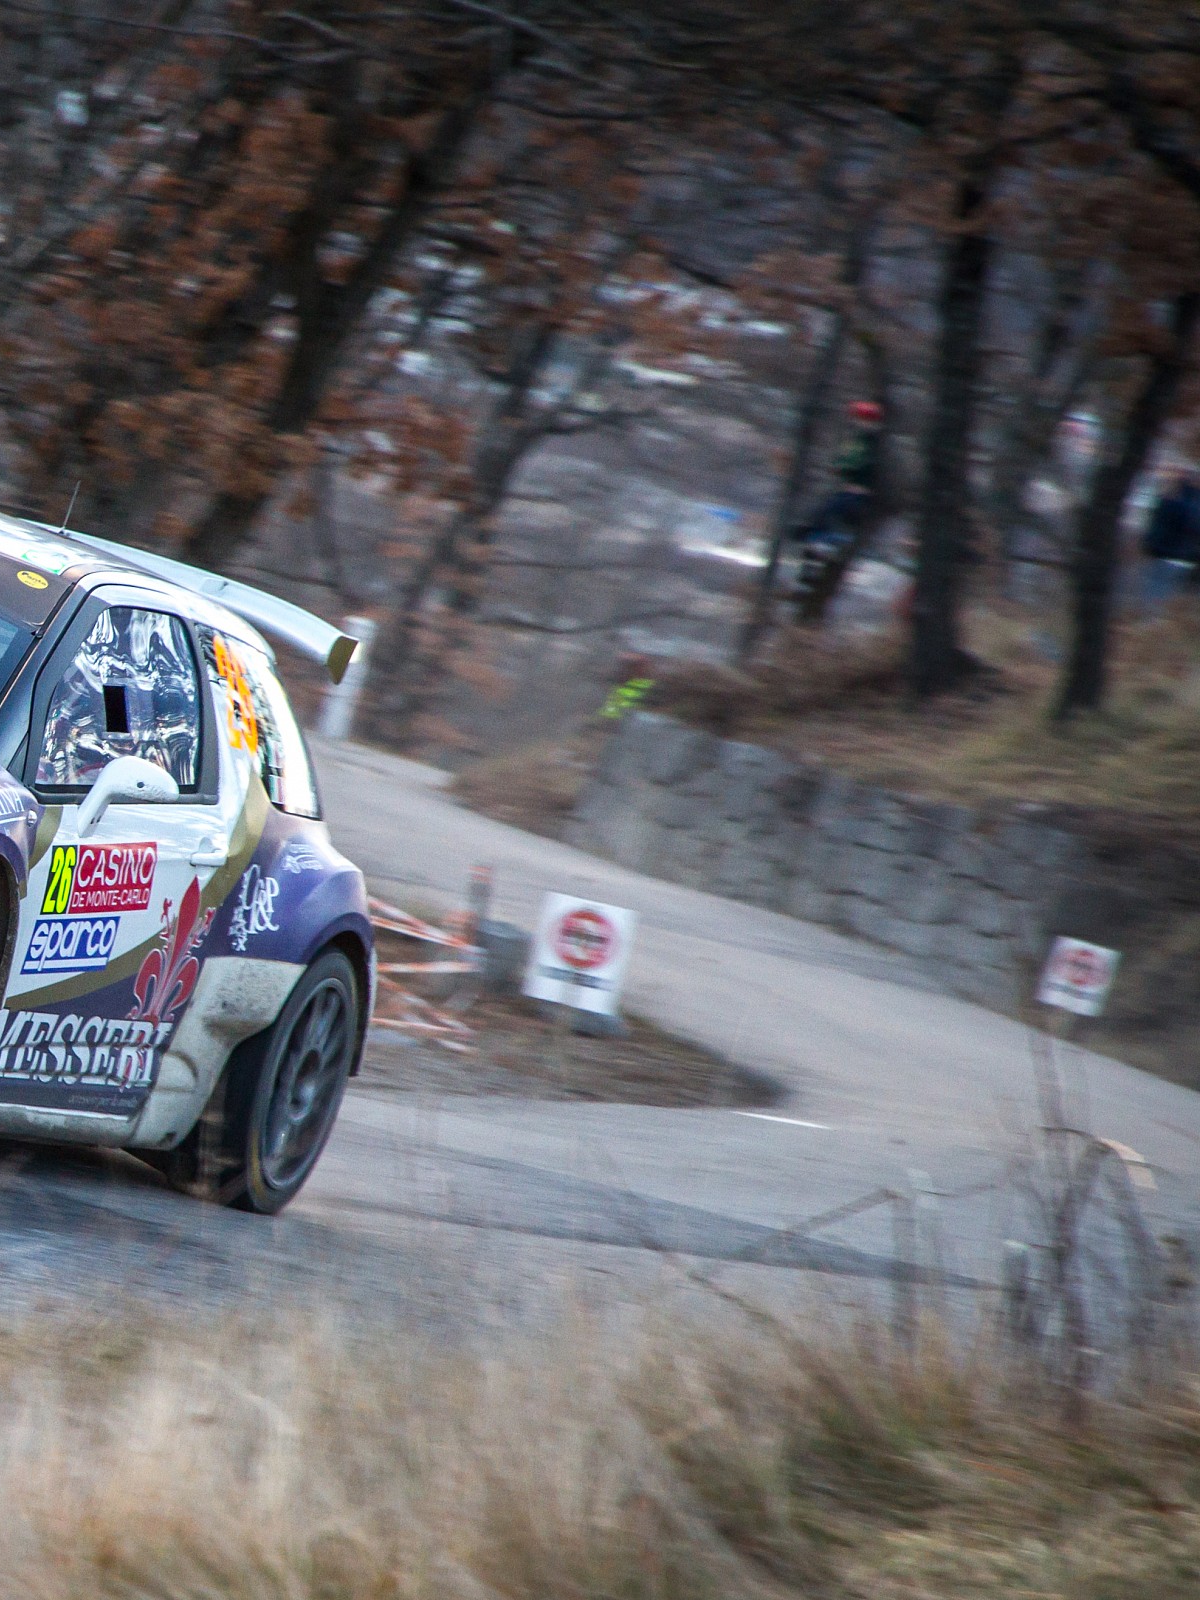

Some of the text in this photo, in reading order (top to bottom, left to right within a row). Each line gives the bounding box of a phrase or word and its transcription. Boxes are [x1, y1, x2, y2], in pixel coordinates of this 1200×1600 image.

[42, 846, 76, 914] 26
[77, 846, 156, 888] CASINO
[71, 888, 150, 908] DE MONTE-CARLO
[30, 919, 117, 972] sparco
